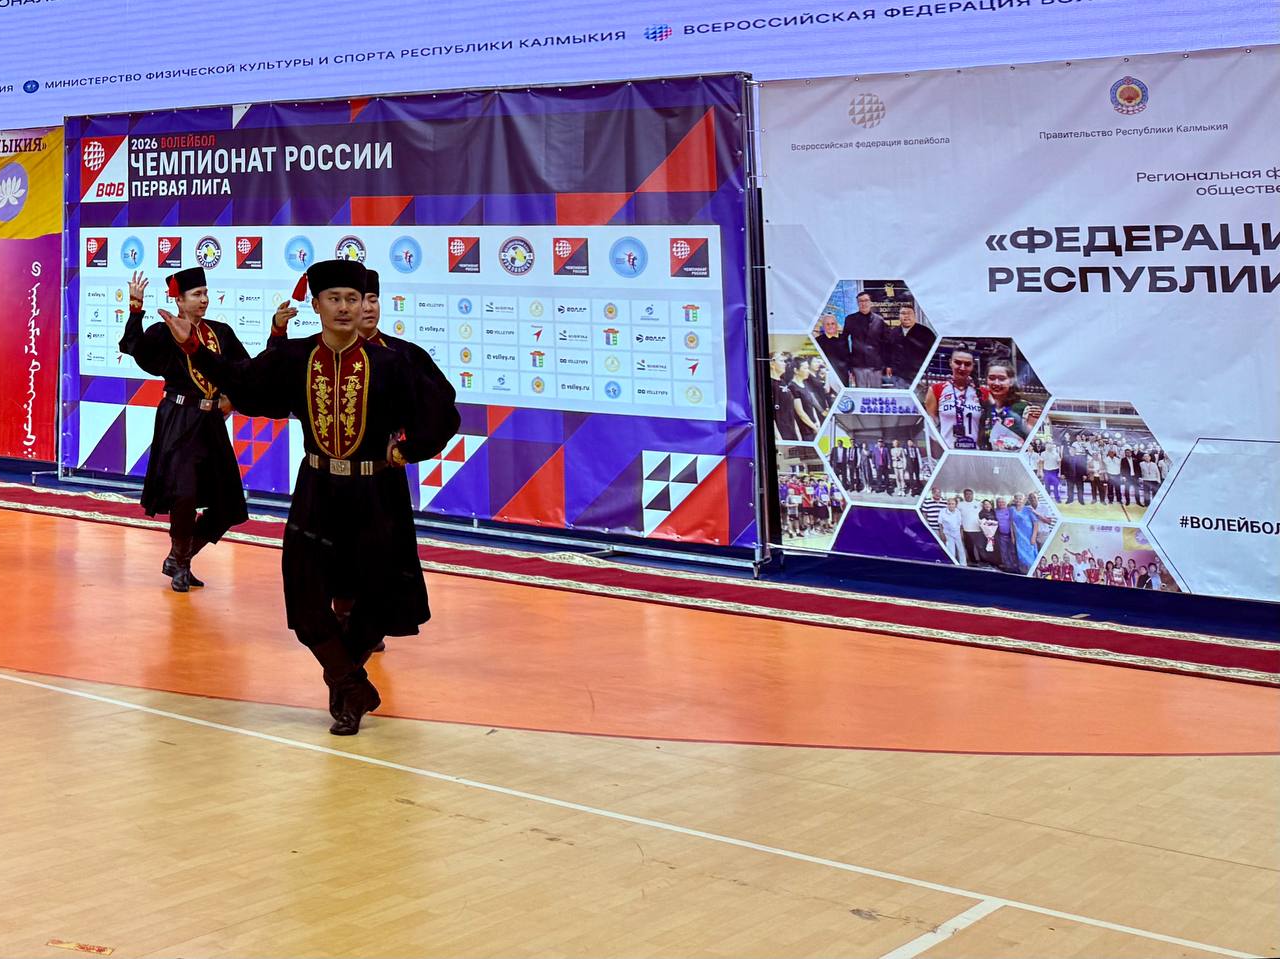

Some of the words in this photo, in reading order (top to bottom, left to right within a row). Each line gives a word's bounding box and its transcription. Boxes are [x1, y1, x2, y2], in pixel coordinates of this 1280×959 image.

[683, 8, 876, 35] ВСЕРОССИЙСКАЯ
[44, 72, 142, 89] МИНИСТЕРСТВО
[145, 62, 236, 81] ФИЗИЧЕСКОЙ
[239, 57, 314, 73] КУЛЬТУРЫ
[318, 55, 329, 66] И
[333, 50, 396, 65] СПОРТА
[400, 40, 513, 59] РЕСПУБЛИКИ
[519, 30, 627, 49] КАЛМЫКИЯ
[1038, 127, 1114, 141] Правительство
[1115, 125, 1174, 139] Республики
[1176, 122, 1229, 135] Калмыкия
[131, 137, 158, 151] 2026
[161, 134, 216, 149] ВОЛЕЙБОЛ
[790, 140, 854, 152] Всероссийская
[855, 138, 902, 151] федерация
[903, 134, 951, 147] волейбола
[130, 146, 277, 177] ЧЕМПИОНАТ
[285, 141, 394, 171] РОССИИ
[1136, 169, 1262, 183] Региональная
[96, 181, 125, 198] ВФВ
[131, 180, 187, 197] ПЕРВАЯ
[191, 178, 231, 196] ЛИГА
